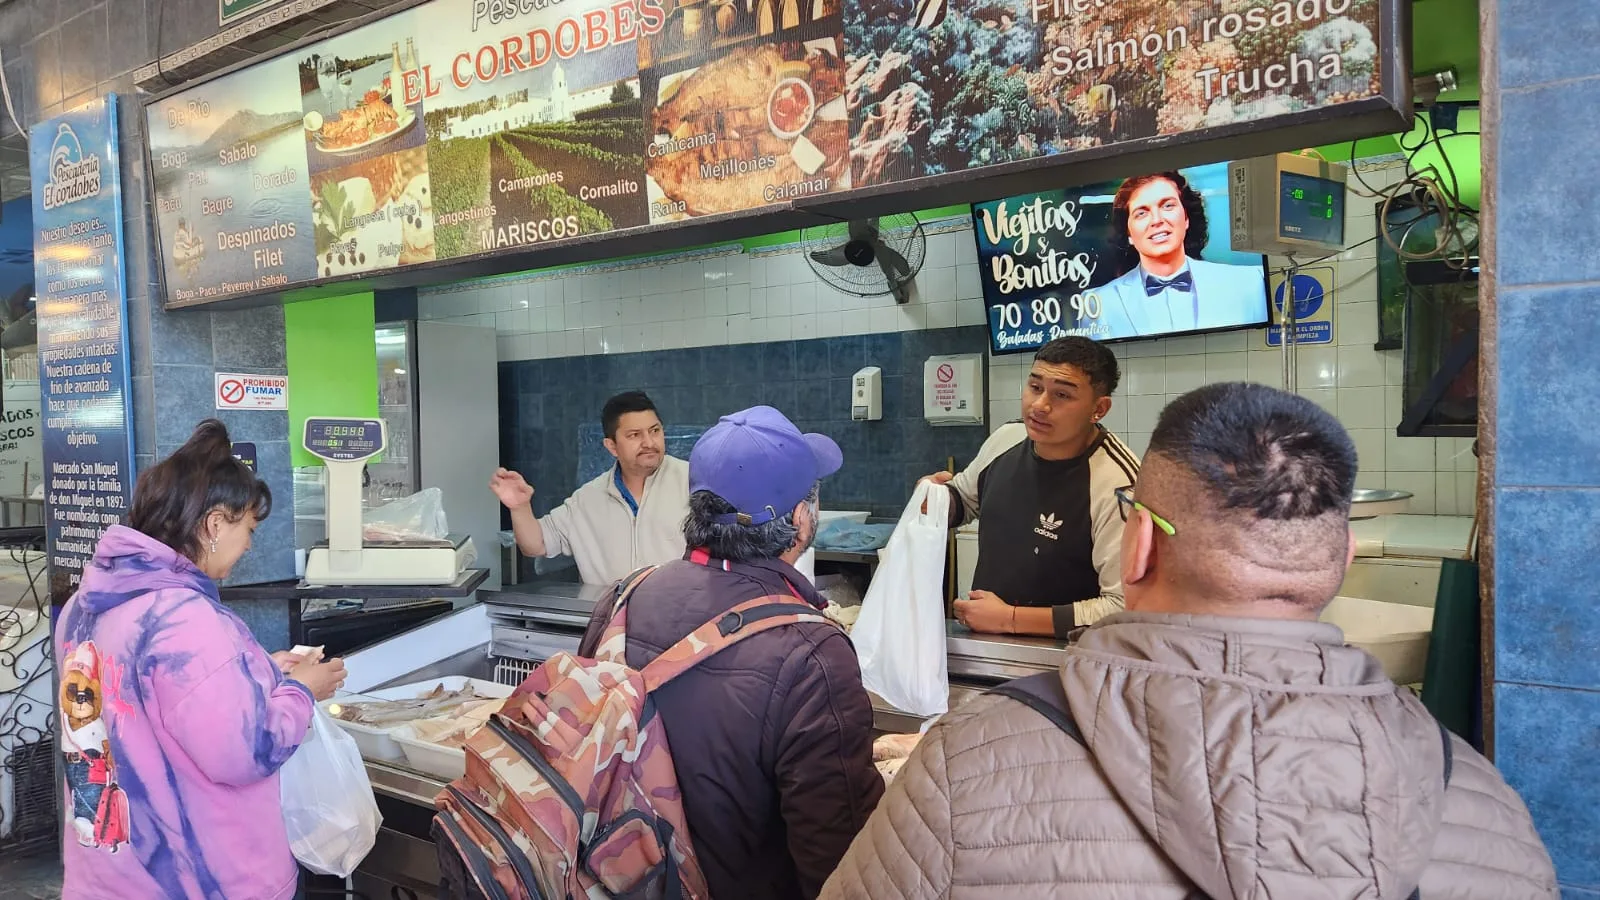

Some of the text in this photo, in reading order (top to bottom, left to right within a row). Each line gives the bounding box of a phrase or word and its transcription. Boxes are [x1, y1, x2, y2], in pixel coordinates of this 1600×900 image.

[1051, 0, 1350, 76] Salmón rosado
[401, 0, 665, 105] EL CORDOBES
[1196, 50, 1340, 100] Trucha
[168, 108, 184, 129] De
[219, 142, 257, 166] Sabalo
[647, 132, 717, 158] Canicama
[161, 151, 188, 168] Boga
[700, 154, 776, 179] Mejillones
[253, 166, 296, 190] Dorado
[499, 170, 564, 193] Camarones
[45, 177, 99, 206] El cordobes
[580, 179, 638, 201] Cornalito
[763, 176, 831, 201] Calamar
[202, 196, 233, 216] Bagre
[433, 204, 497, 227] Langostinos
[651, 200, 687, 218] Rana
[41, 226, 66, 241] Nuestro
[70, 221, 90, 236] deseo
[217, 220, 296, 250] Despinados
[482, 215, 579, 249] MARISCOS
[982, 197, 1082, 255] Viejitas
[254, 249, 283, 269] Filet
[262, 273, 288, 287] Sabalo
[992, 248, 1097, 294] Bonitas
[992, 292, 1101, 330] 70 80 90
[86, 342, 117, 357] intactas.
[997, 330, 1044, 349] Baladas
[46, 358, 112, 378] Nuestra cadena de
[64, 378, 73, 394] de
[74, 377, 109, 392] avanzada
[243, 379, 285, 388] PROHIBIDO
[245, 386, 282, 395] FUMAR
[49, 397, 64, 411] hace
[67, 430, 98, 448] objetivo.
[53, 461, 118, 478] Mercado San Miguel
[52, 477, 121, 494] donado por la familia
[49, 492, 126, 510] de don Miguel en 1892.
[54, 508, 120, 525] Fue nombrado como
[61, 525, 95, 539] patrimonio
[1034, 527, 1058, 540] adidas
[56, 538, 93, 554] humanidad.
[54, 556, 81, 569] mercado
